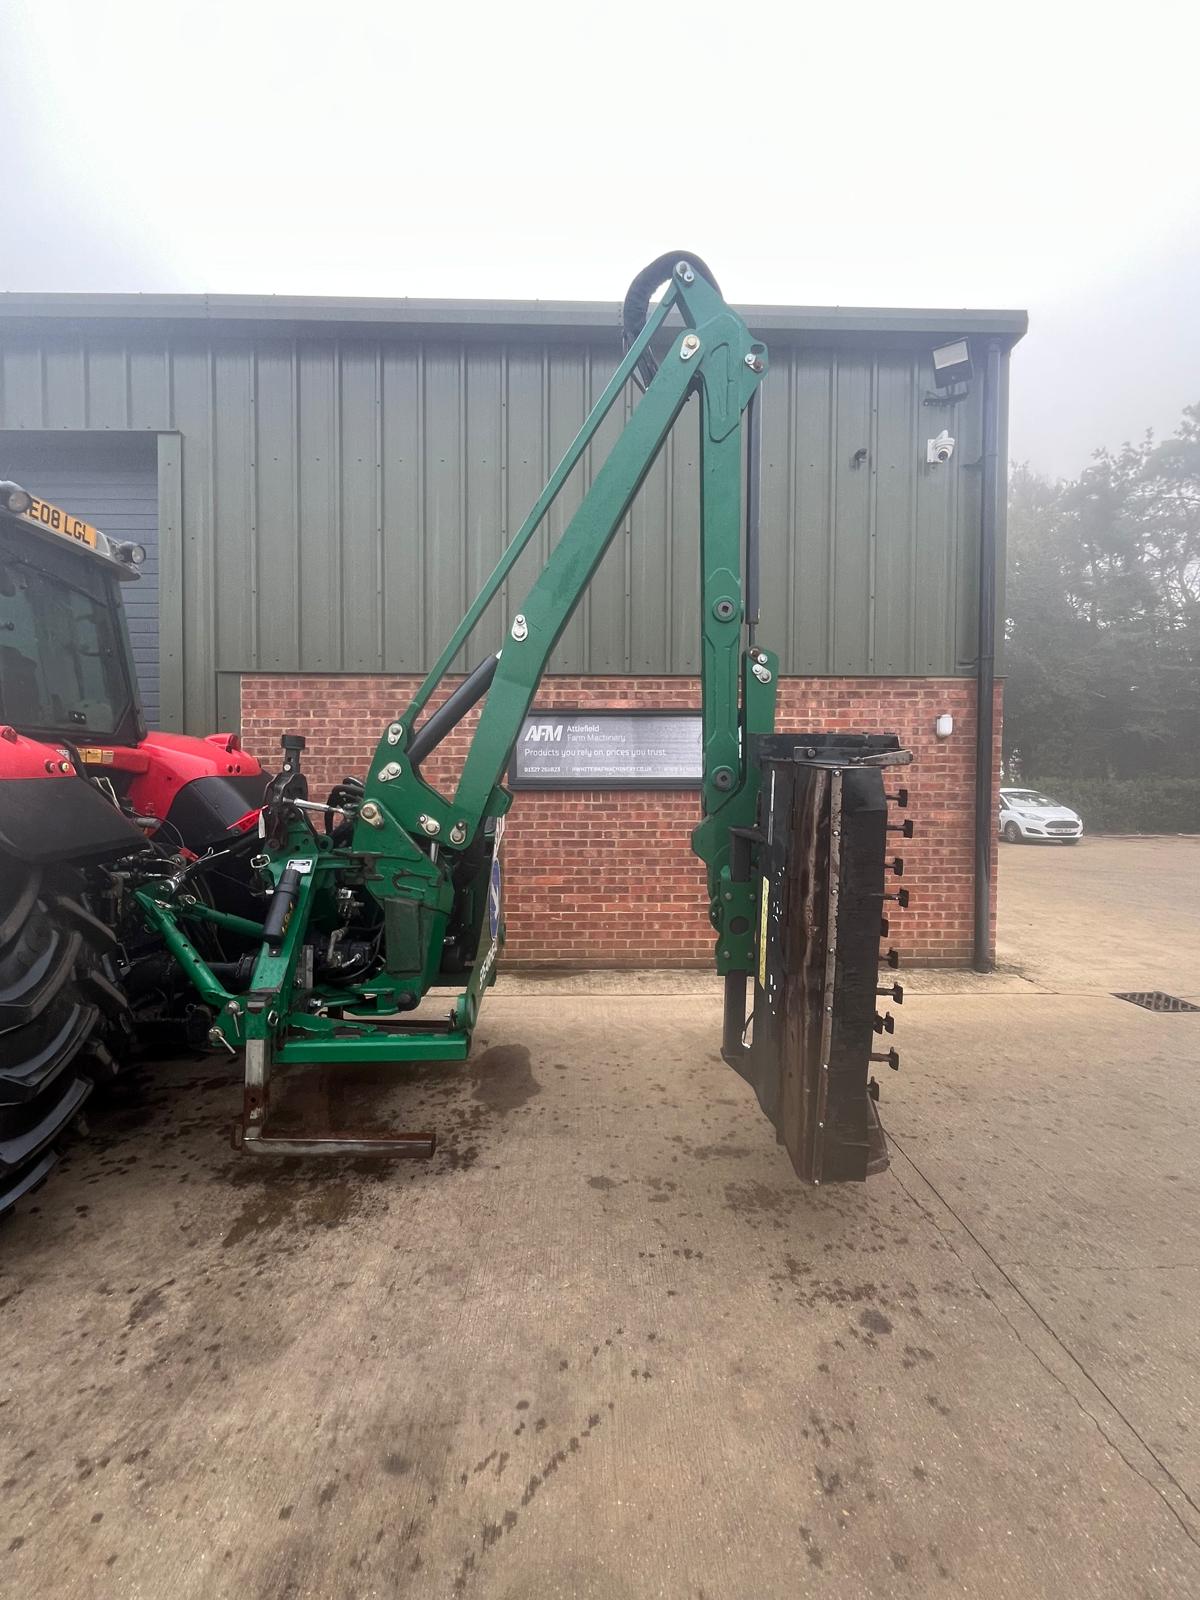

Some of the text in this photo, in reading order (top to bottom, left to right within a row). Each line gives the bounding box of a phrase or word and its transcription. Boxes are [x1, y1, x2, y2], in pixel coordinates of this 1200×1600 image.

[23, 498, 91, 545] E08 LGL
[524, 724, 564, 742] AFM
[566, 733, 626, 743] Farm Machinery
[524, 748, 666, 758] Products you rely on prices you trust
